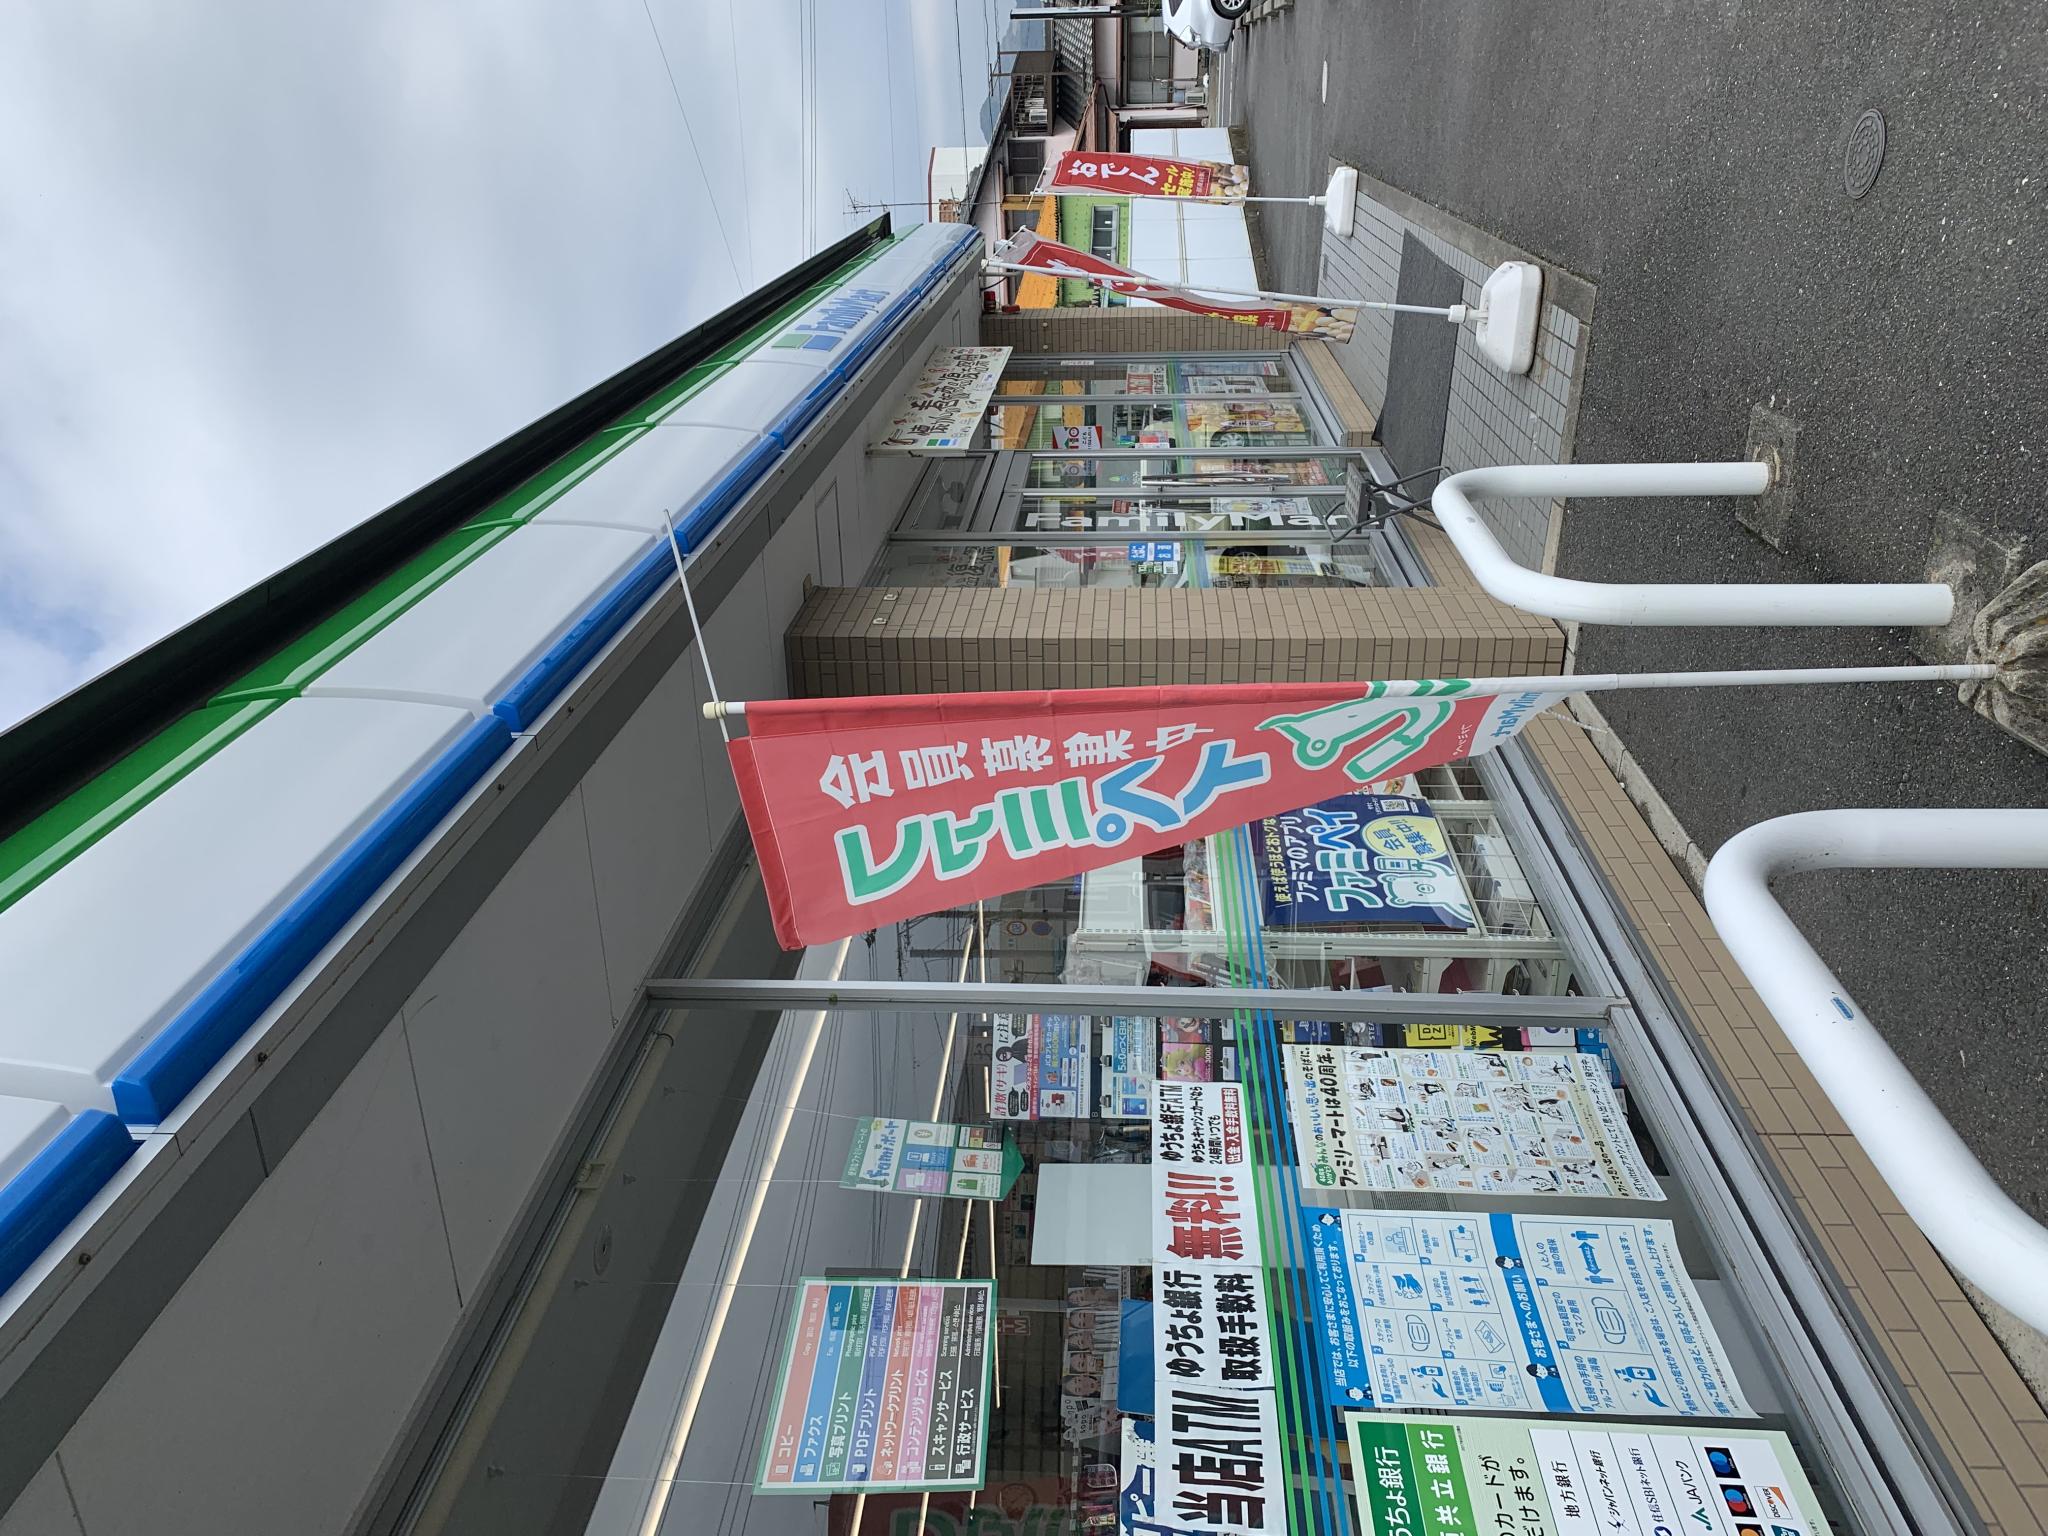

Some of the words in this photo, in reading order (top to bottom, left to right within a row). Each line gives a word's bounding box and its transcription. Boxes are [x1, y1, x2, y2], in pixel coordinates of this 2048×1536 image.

[1067, 158, 1160, 186] おでん
[1160, 164, 1179, 196] セール
[1176, 166, 1196, 196] 実施中!
[794, 288, 890, 335] FamilyMart
[1264, 817, 1292, 902] 使えば使うほどおトクな
[1280, 816, 1320, 902] ファミマのアプリ
[1302, 808, 1384, 911] ファミペイ
[1373, 827, 1406, 851] 会員
[1392, 818, 1437, 856] 募集中!!
[1117, 1018, 1126, 1070] 5と0のつく日は
[1204, 1047, 1212, 1064] 3000
[994, 1064, 1008, 1116] 詐欺(サギ)
[1158, 1084, 1185, 1162] ゆうちょ銀行ATM
[1300, 1046, 1328, 1164] みんなのおいしい思い出のそばに。
[1316, 1047, 1358, 1186] ファミリーマートは40周年。
[1189, 1086, 1206, 1163] ゆうちょキャッシュカードなら
[1206, 1114, 1222, 1164] 24時間いつでも
[1224, 1088, 1242, 1162] 出金・入金手数料無料
[1164, 1172, 1244, 1260] 無料!!
[1536, 1242, 1551, 1270] 人と人の
[1547, 1238, 1566, 1275] 距離の確保
[943, 1316, 951, 1334] services
[1163, 1270, 1206, 1378] ゆうちょ銀行
[1214, 1274, 1262, 1381] 取扱手数料
[1310, 1224, 1348, 1386] 当店では、お客さまに安心してご利用頂くため
[1328, 1239, 1360, 1368] 以下の取組みをおこなっております。
[1512, 1274, 1546, 1358] お客さまへのお願い
[1552, 1292, 1576, 1342] 可能な範囲での
[1566, 1300, 1586, 1335] マスク着用
[940, 1336, 950, 1356] Scanning
[880, 1370, 904, 1456] ネットワークプリント
[907, 1368, 928, 1456] コンテンツサービス
[932, 1370, 952, 1456] スキャンサービス
[1574, 1356, 1601, 1408] 入店時の手指の
[1588, 1357, 1616, 1408] アルコール消毒
[778, 1424, 793, 1458] コピー
[804, 1416, 824, 1458] ファクス
[828, 1392, 851, 1458] 写真プリント
[854, 1388, 877, 1456] PDFプリント
[956, 1388, 974, 1456] 行政サービス
[1172, 1390, 1265, 1529] 当店ATM
[1419, 1430, 1464, 1536] 共立銀行
[1550, 1460, 1581, 1518] 地方銀行
[1588, 1450, 1621, 1516] ジャパンネット銀行
[1628, 1448, 1665, 1522] 住信SBIネット銀行
[1675, 1460, 1703, 1505] JAバンク
[1762, 1488, 1781, 1518] DISCOVER
